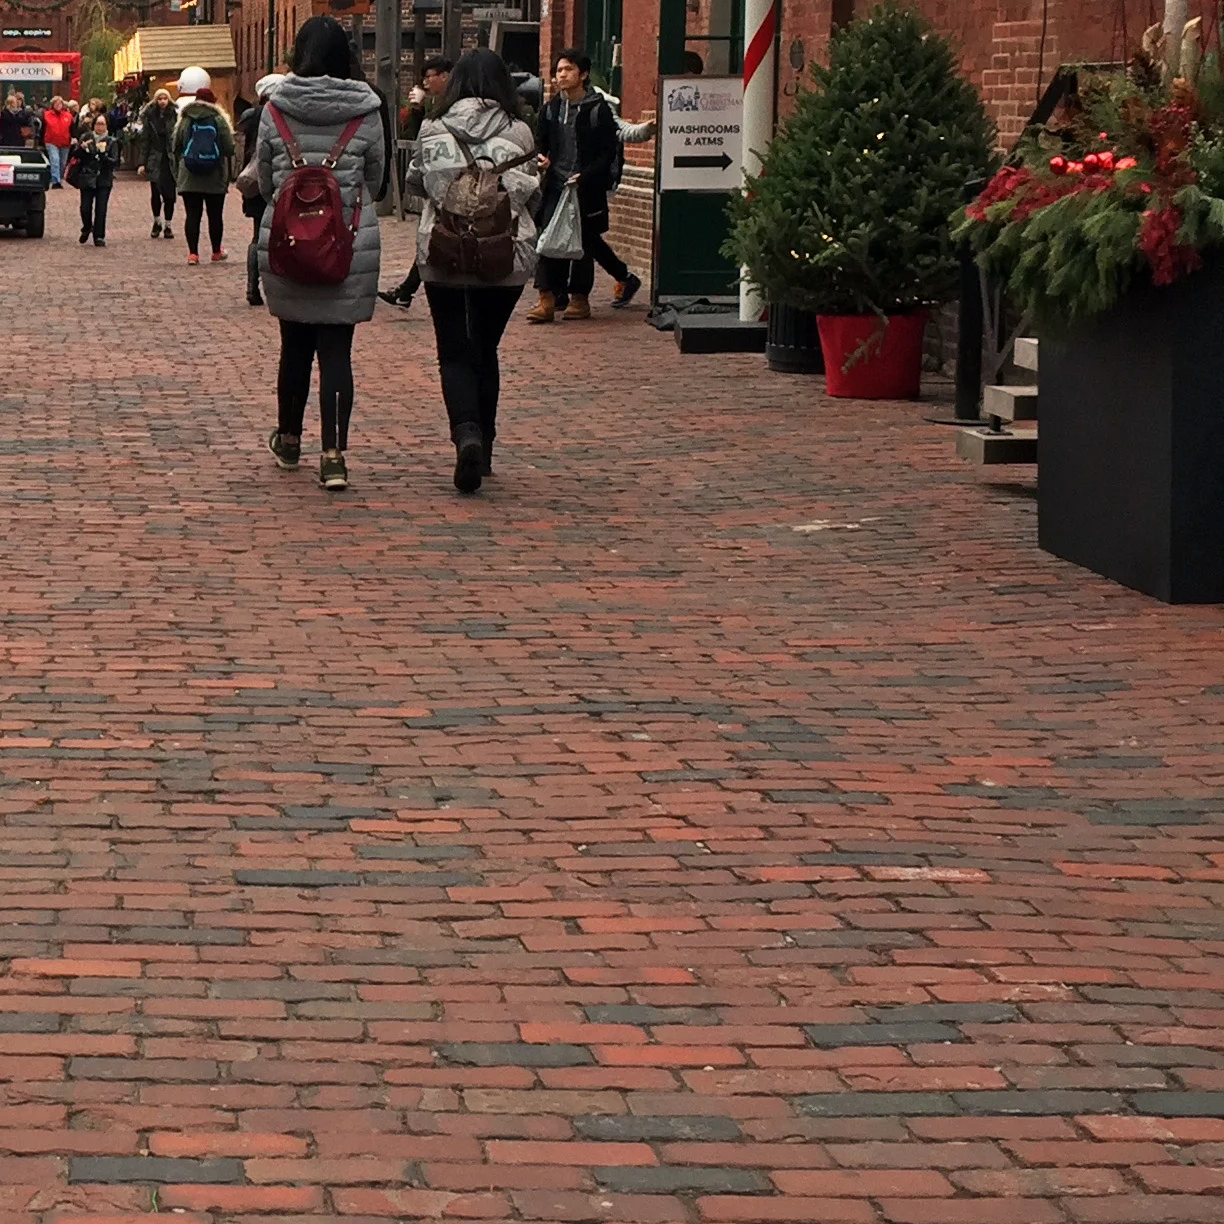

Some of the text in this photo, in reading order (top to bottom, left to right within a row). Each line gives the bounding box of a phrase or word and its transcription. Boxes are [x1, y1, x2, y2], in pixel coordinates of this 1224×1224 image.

[0, 67, 20, 75] COP
[668, 124, 741, 134] WASHROOMS
[684, 137, 724, 146] & ATMS
